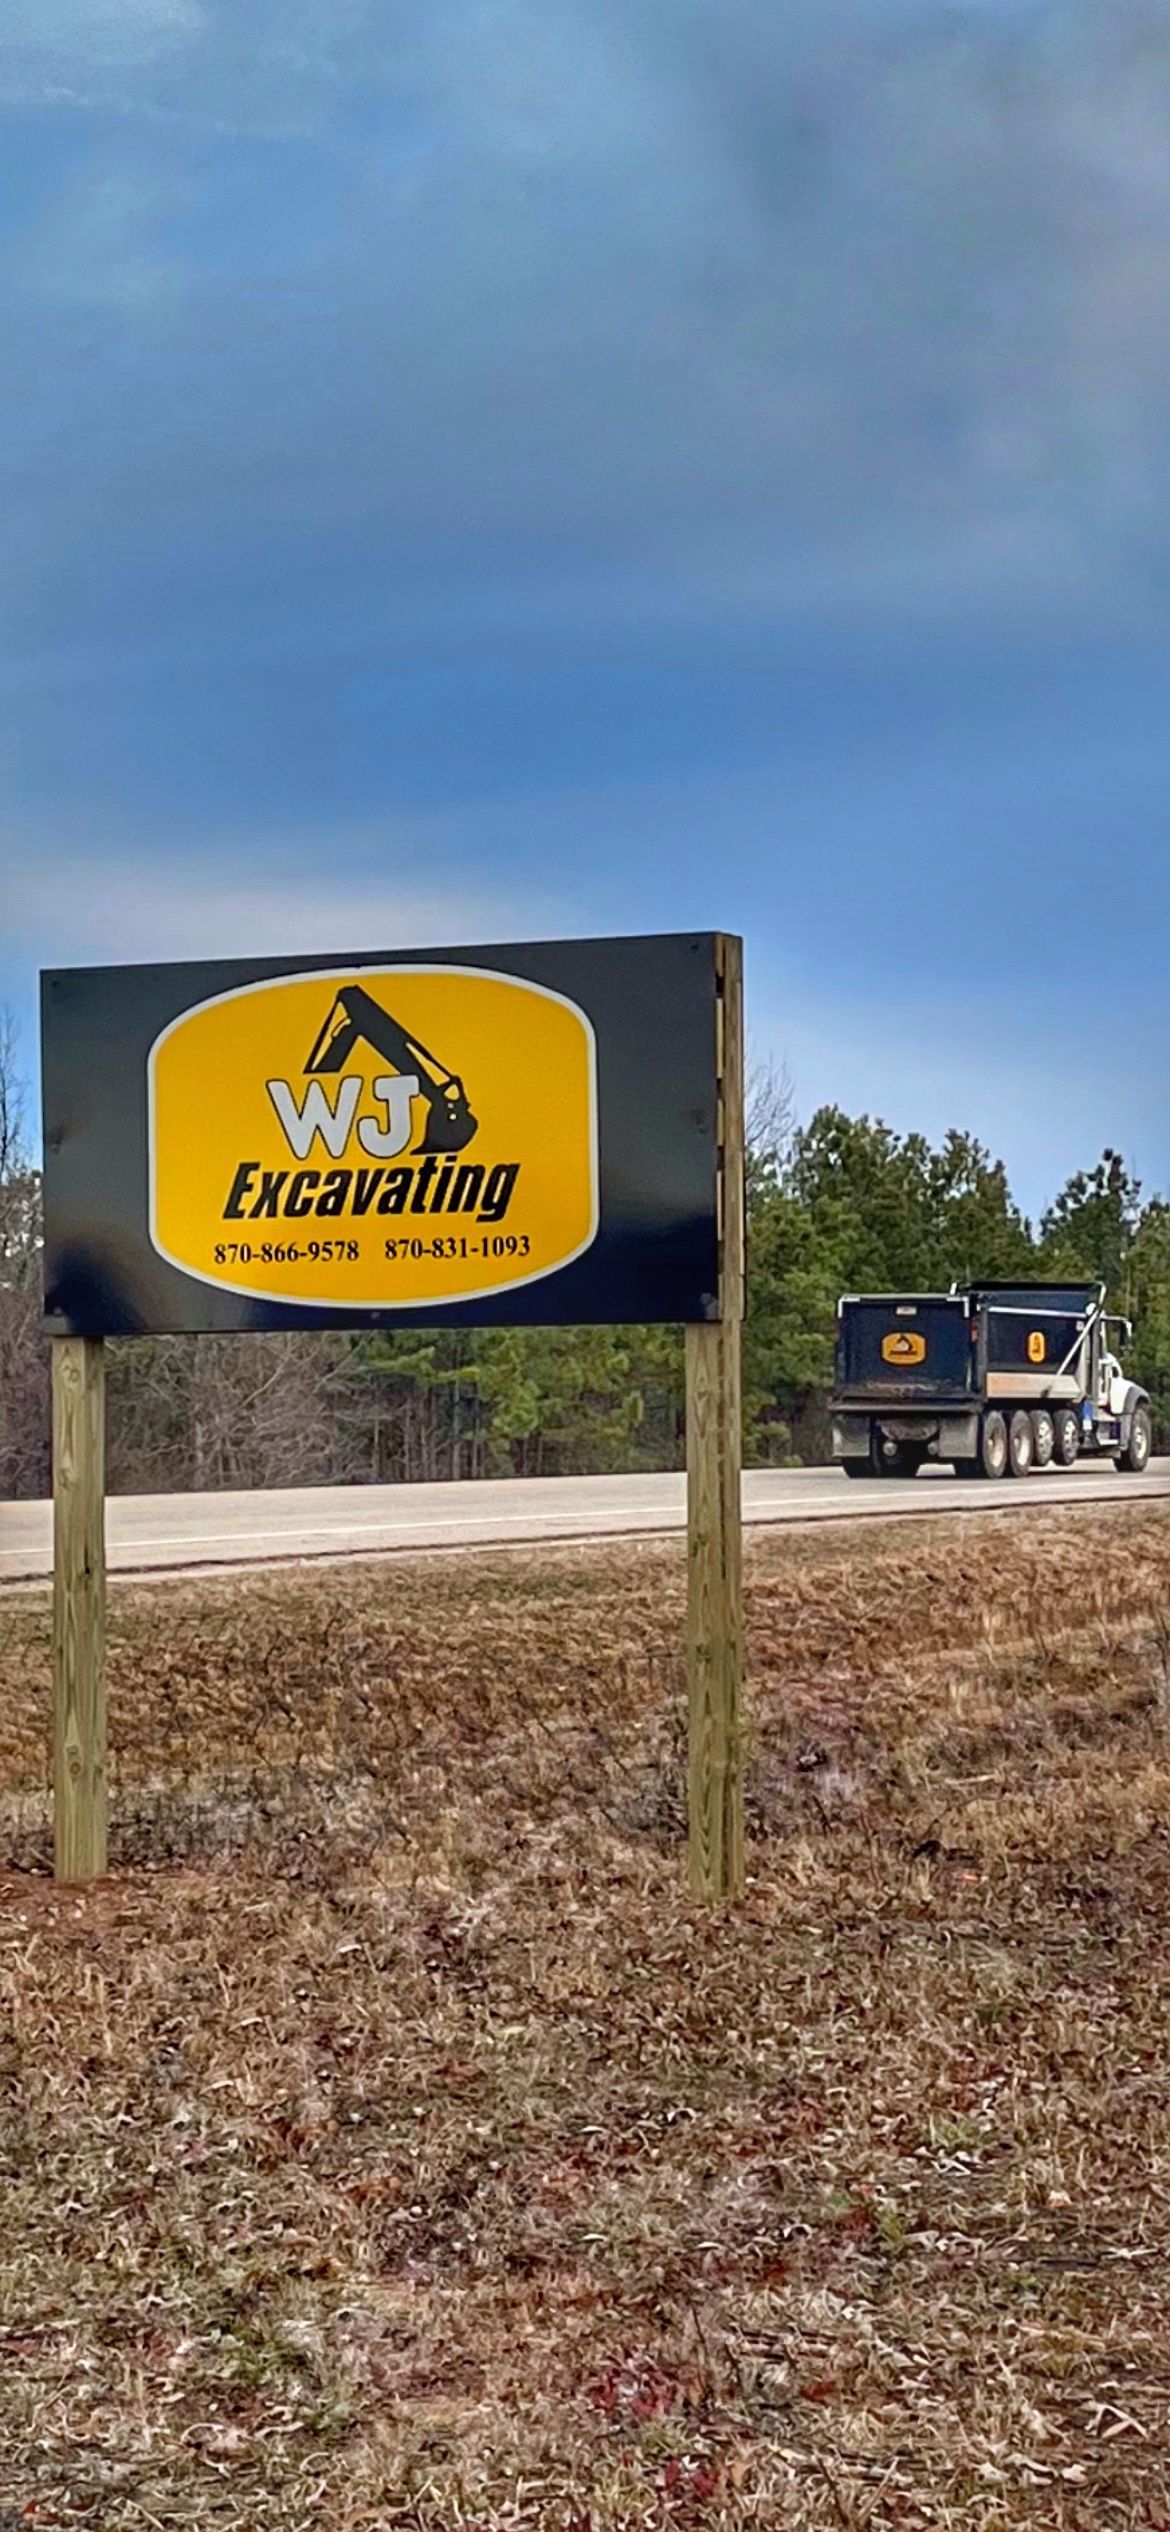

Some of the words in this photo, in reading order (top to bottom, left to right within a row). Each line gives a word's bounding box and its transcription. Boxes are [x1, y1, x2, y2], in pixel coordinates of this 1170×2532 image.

[266, 1075, 420, 1160] WJ
[222, 1155, 520, 1222] Excavating
[213, 1240, 360, 1264] 870-866-9578
[385, 1235, 531, 1260] 870-831-1093
